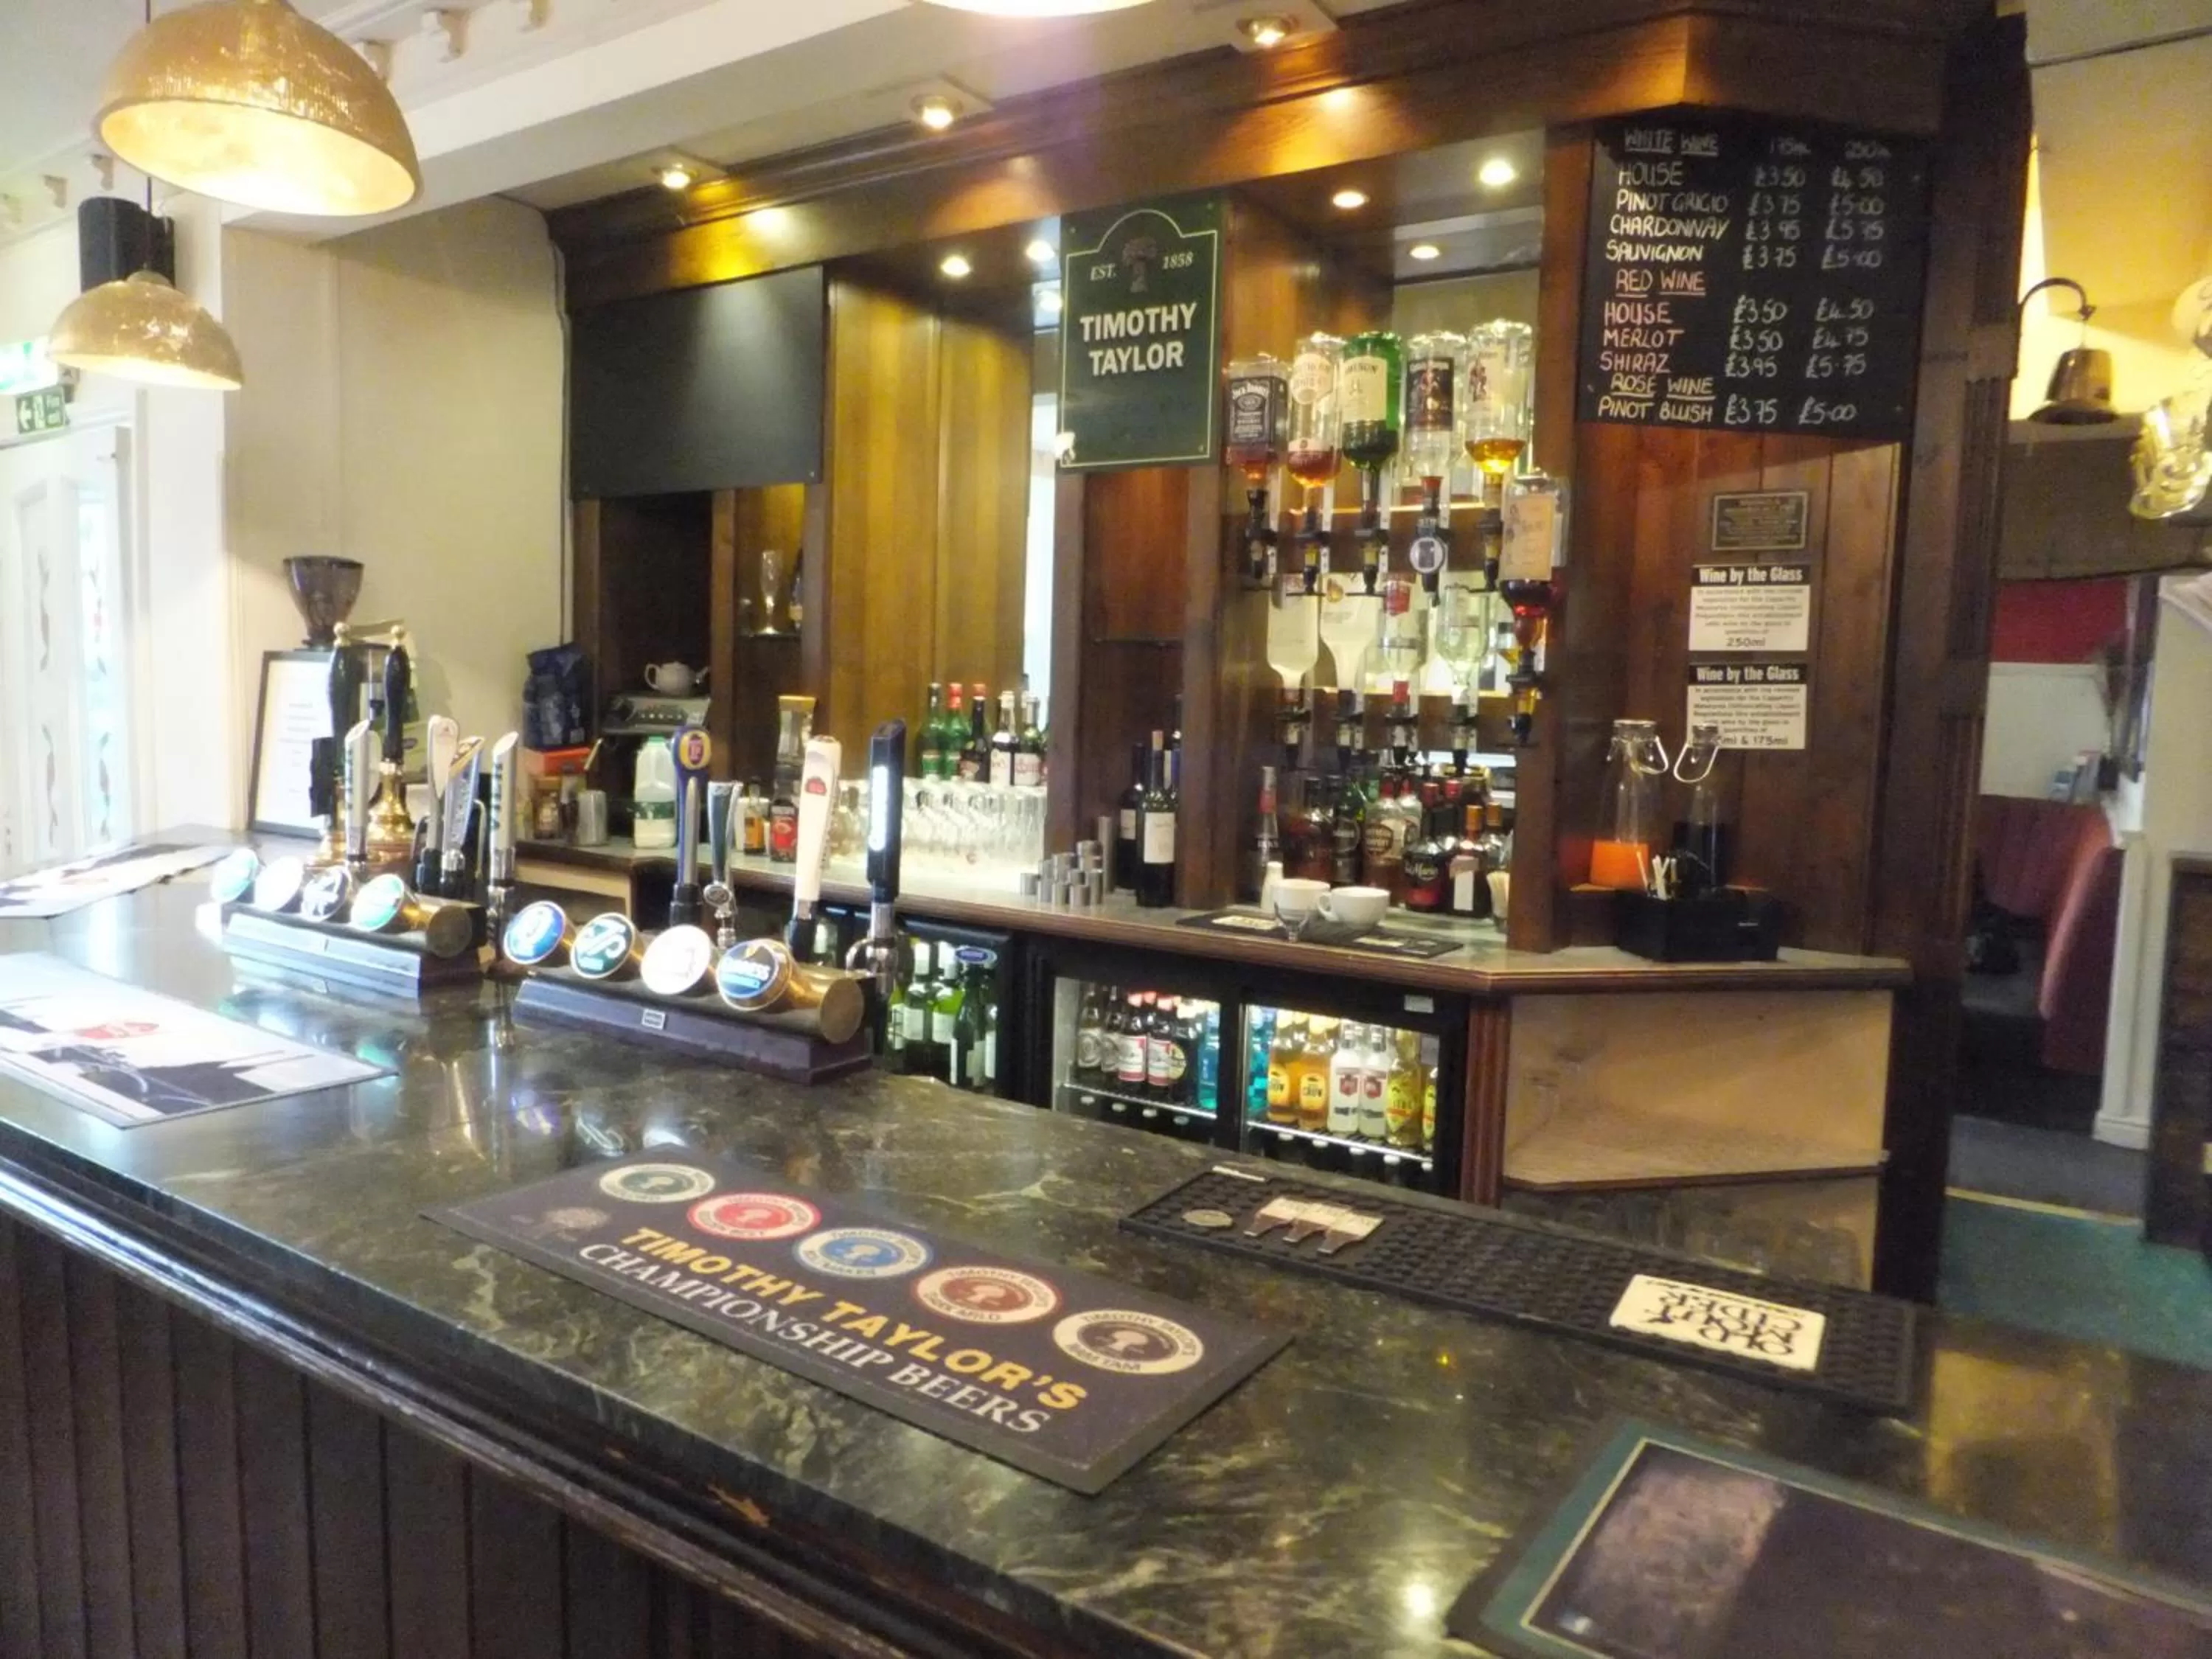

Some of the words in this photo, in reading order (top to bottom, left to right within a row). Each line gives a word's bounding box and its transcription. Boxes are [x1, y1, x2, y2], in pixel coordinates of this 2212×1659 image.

[1618, 160, 1684, 187] HOUSE
[1616, 188, 1672, 212] PINOT
[1610, 213, 1731, 240] CHARDONNAY
[1161, 251, 1194, 271] 1858
[1605, 238, 1704, 263] SAUVIGNON
[1615, 268, 1654, 292] RED
[1660, 268, 1706, 292] WINE
[1079, 300, 1198, 343] TIMOTHY
[1604, 302, 1674, 326] HOUSE
[1603, 327, 1685, 349] MERLOT
[1088, 340, 1184, 378] TAYLOR
[1599, 351, 1672, 374] SHIRAZ
[1666, 377, 1714, 396] WINE
[1597, 395, 1655, 420] PINOT
[1659, 400, 1714, 424] BLUSH
[1699, 567, 1728, 584] Wine
[1729, 566, 1745, 586] by
[1747, 566, 1768, 583] the
[1770, 565, 1804, 582] Glass
[1696, 665, 1725, 682] Wine
[1726, 665, 1742, 684] by
[1744, 665, 1764, 681] the
[1767, 664, 1801, 681] Glass
[620, 1226, 826, 1307] TIMOTHY
[820, 1301, 1088, 1410] TAYLOR'S
[579, 1243, 895, 1368] CHAMPIONSHIP
[887, 1362, 1052, 1433] BEERS
